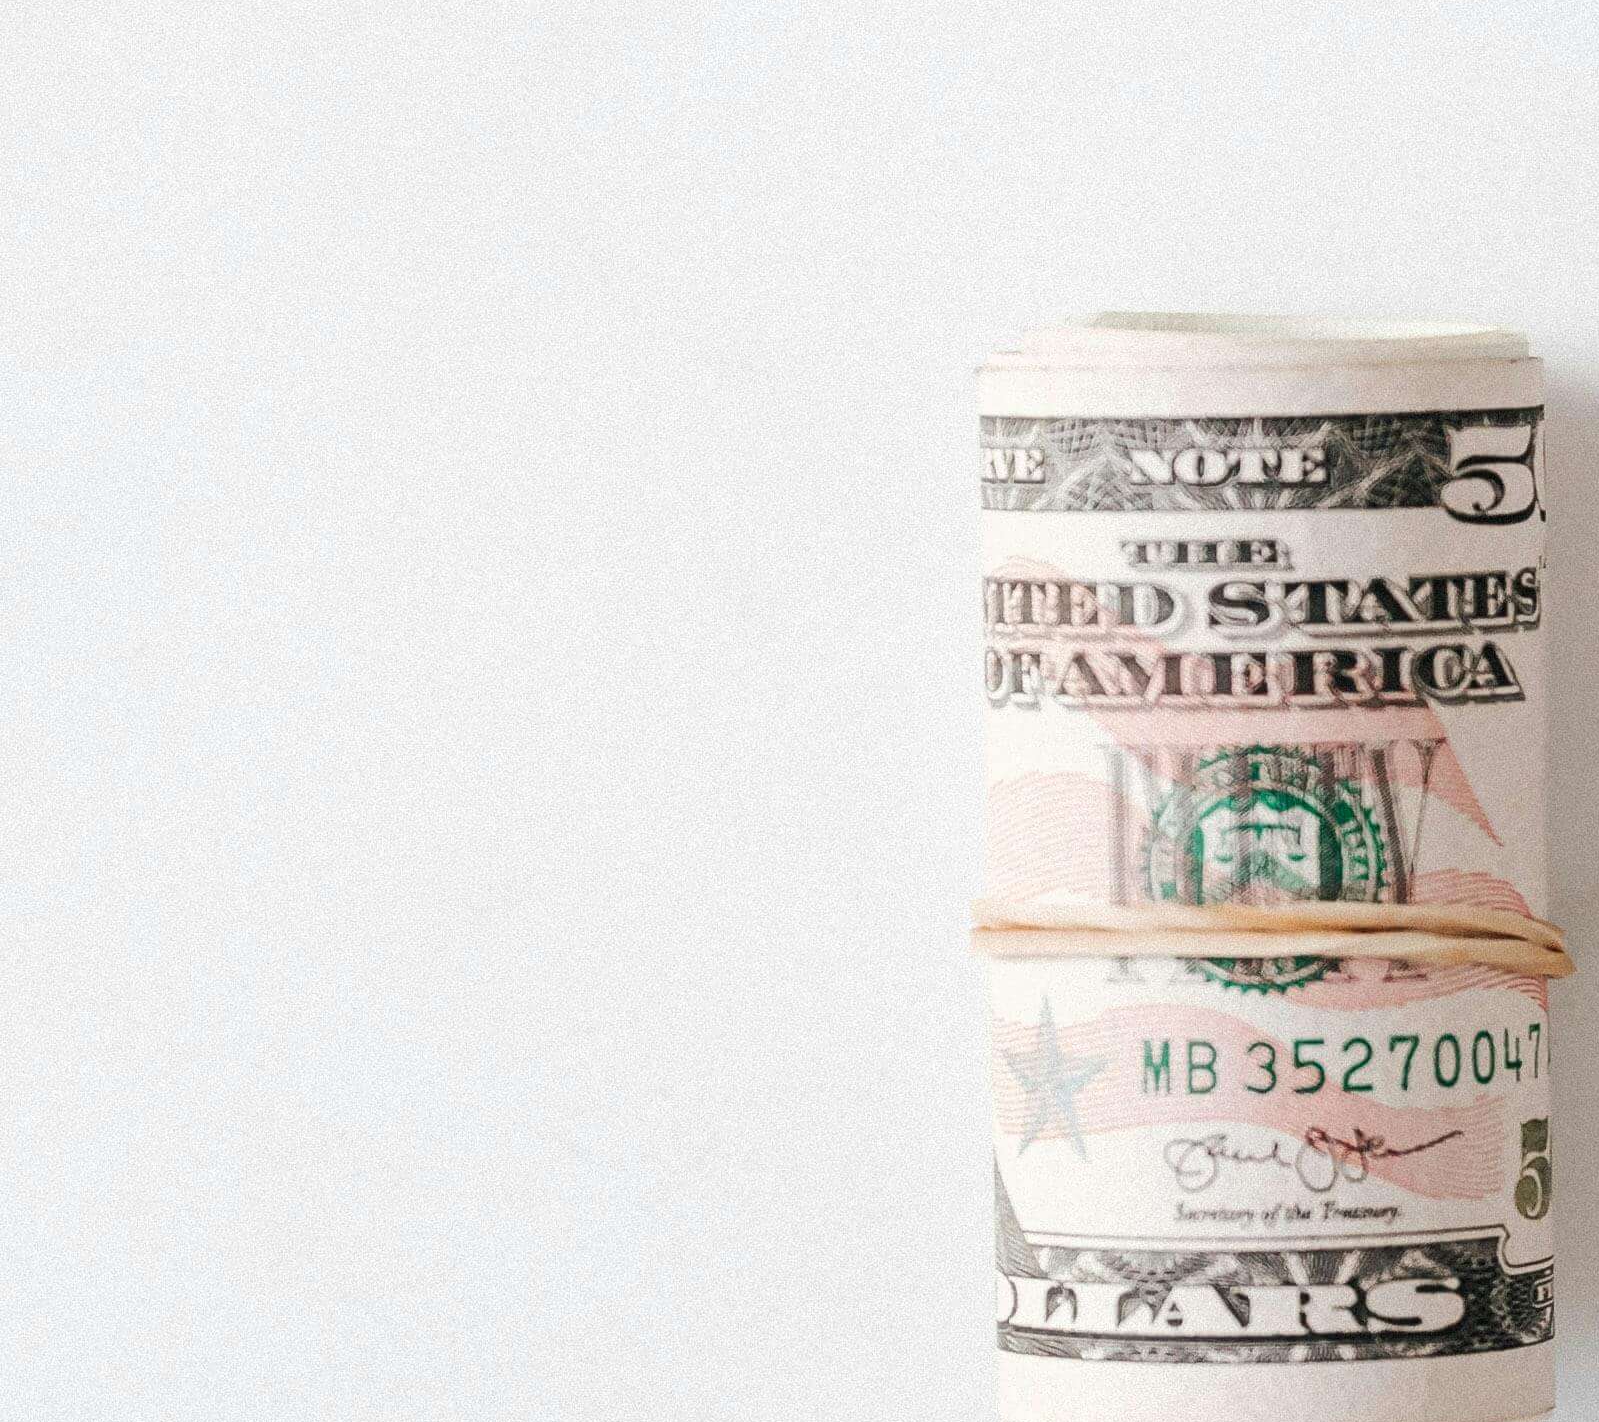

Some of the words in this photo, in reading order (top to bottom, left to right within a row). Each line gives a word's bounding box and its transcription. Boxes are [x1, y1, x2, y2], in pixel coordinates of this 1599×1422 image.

[1128, 447, 1329, 486] NOTE
[1120, 539, 1295, 572] THE
[983, 575, 1195, 637] ITED
[1208, 565, 1541, 639] STATES
[1055, 641, 1526, 710] AMERICA
[1175, 1201, 1256, 1229] Secretary
[1261, 1202, 1282, 1228] of
[1285, 1202, 1312, 1222] the
[992, 1272, 1466, 1336] LLARS
